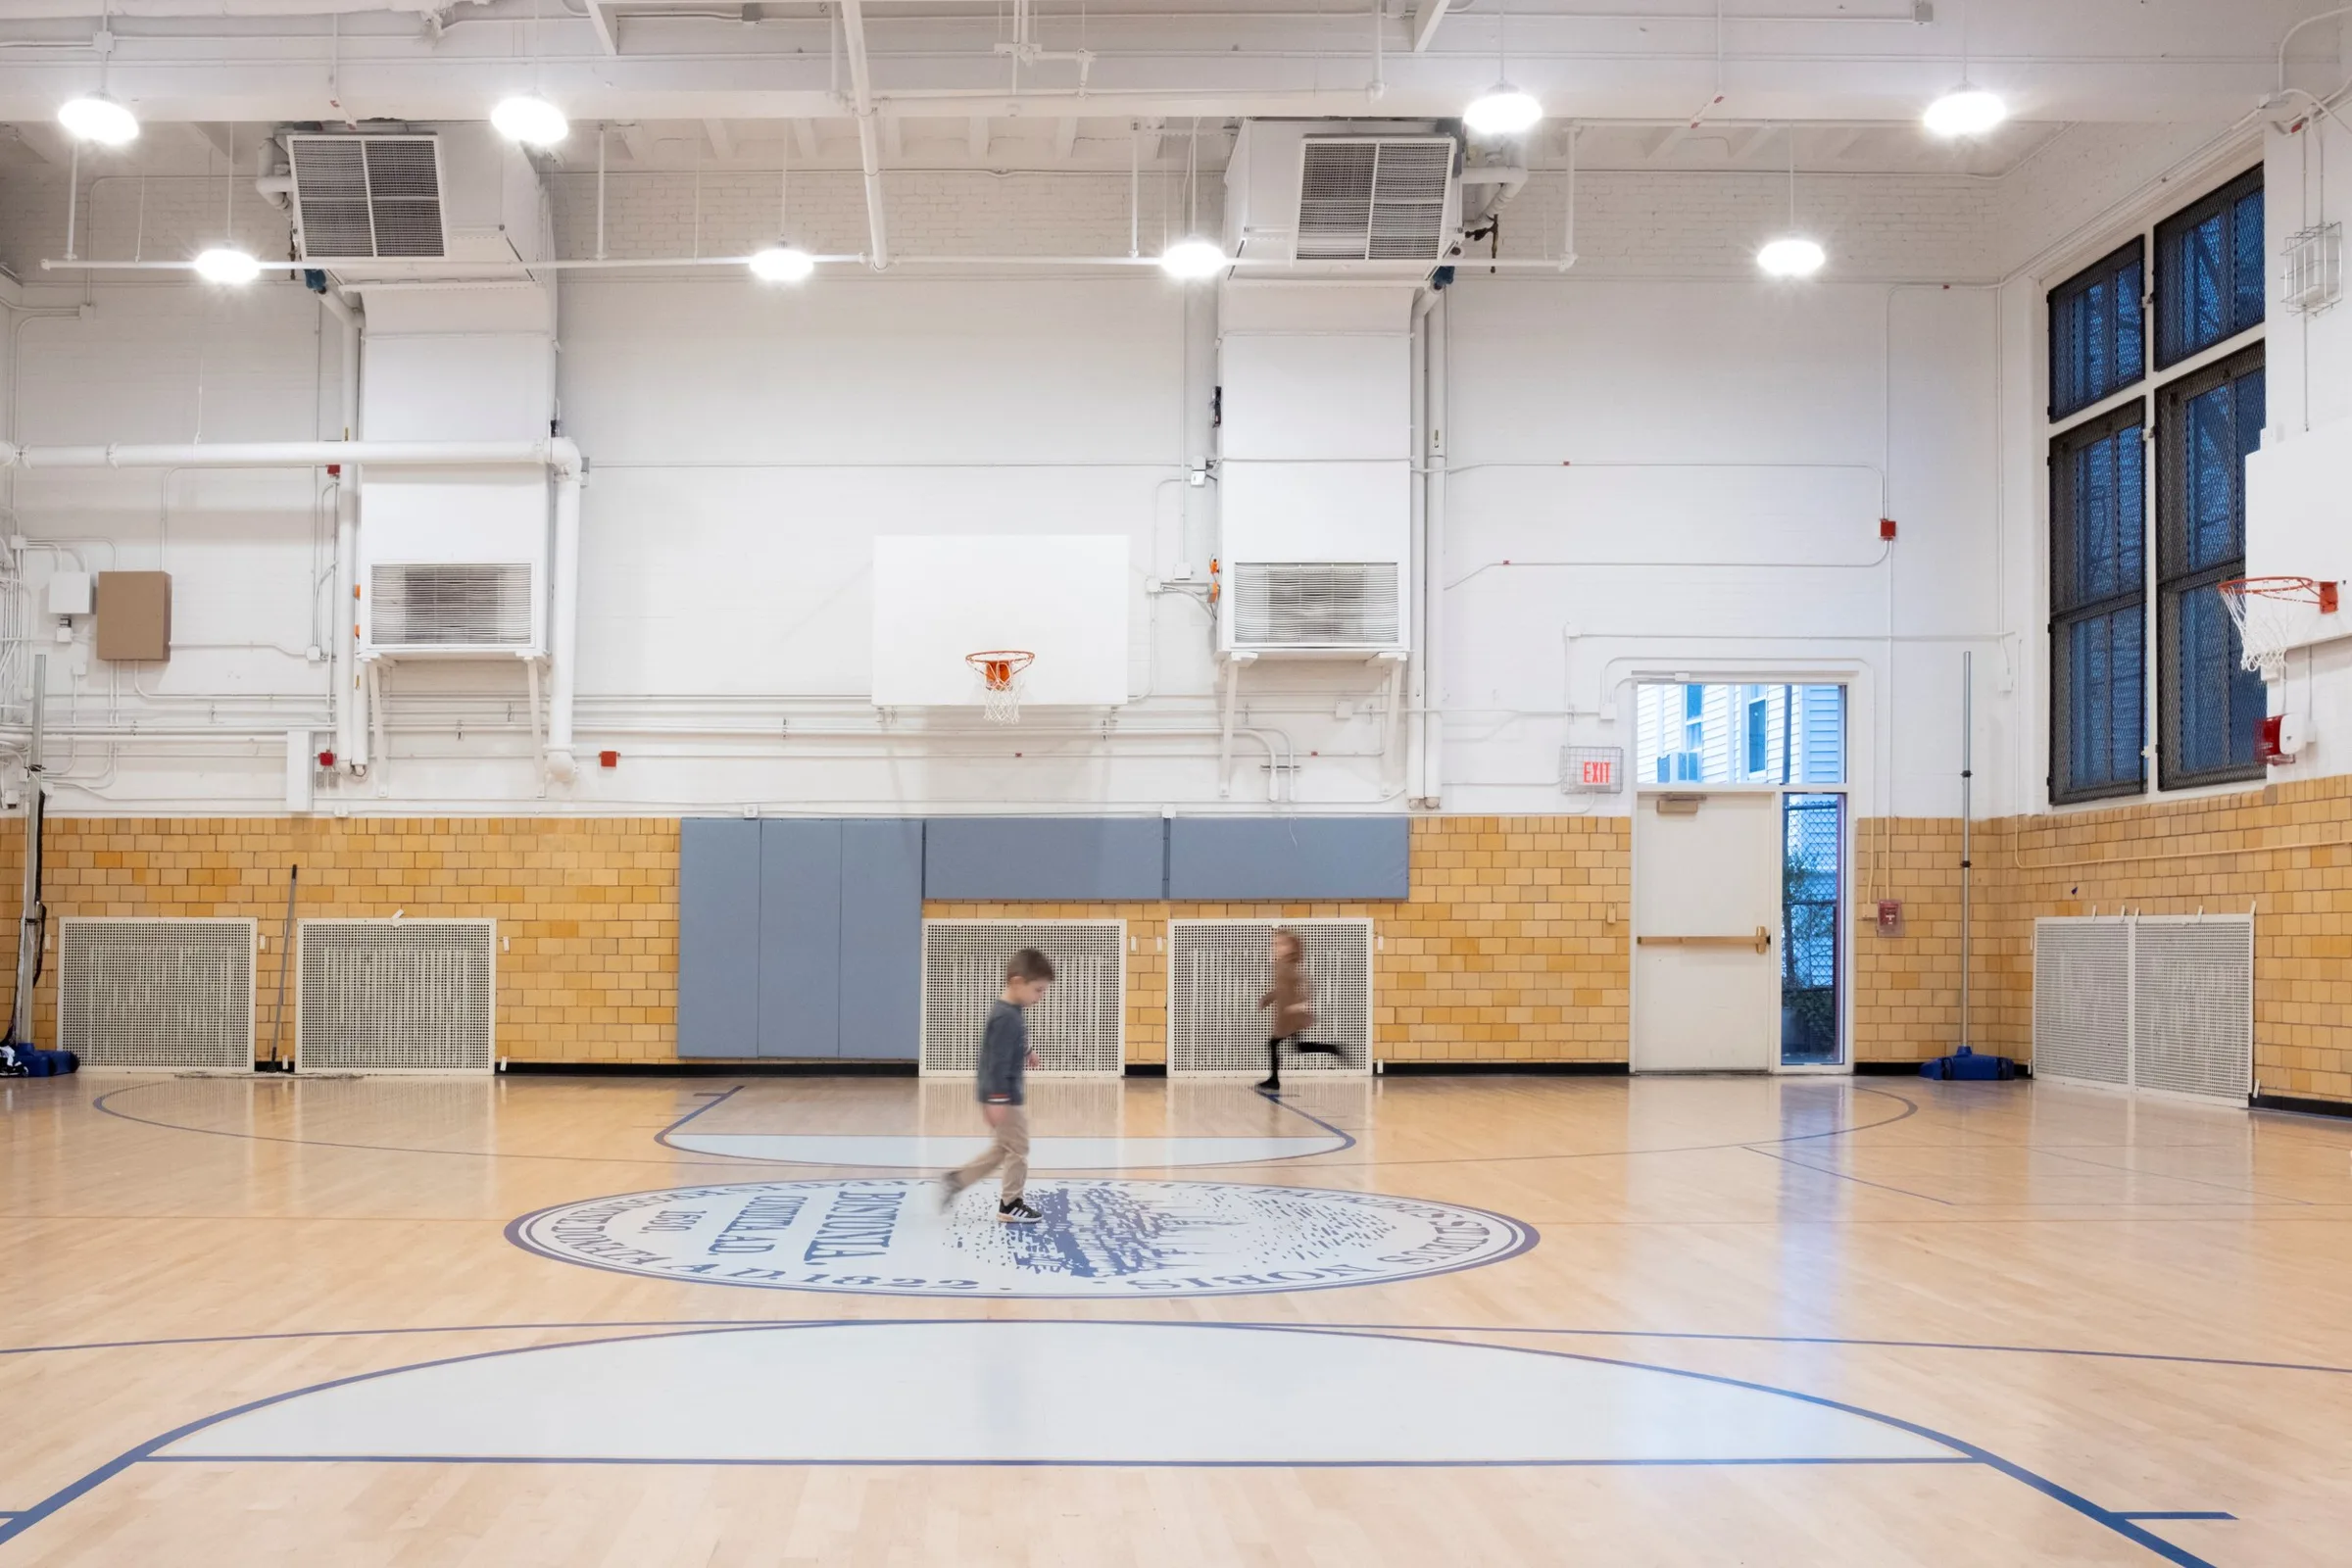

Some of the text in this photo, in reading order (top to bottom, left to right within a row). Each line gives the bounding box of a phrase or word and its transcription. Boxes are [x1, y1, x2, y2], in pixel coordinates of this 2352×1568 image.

[1583, 761, 1611, 784] EXIT
[722, 1196, 809, 1234] CONDITA
[551, 1225, 673, 1265] DONATA
[1377, 1237, 1490, 1265] DEUS
